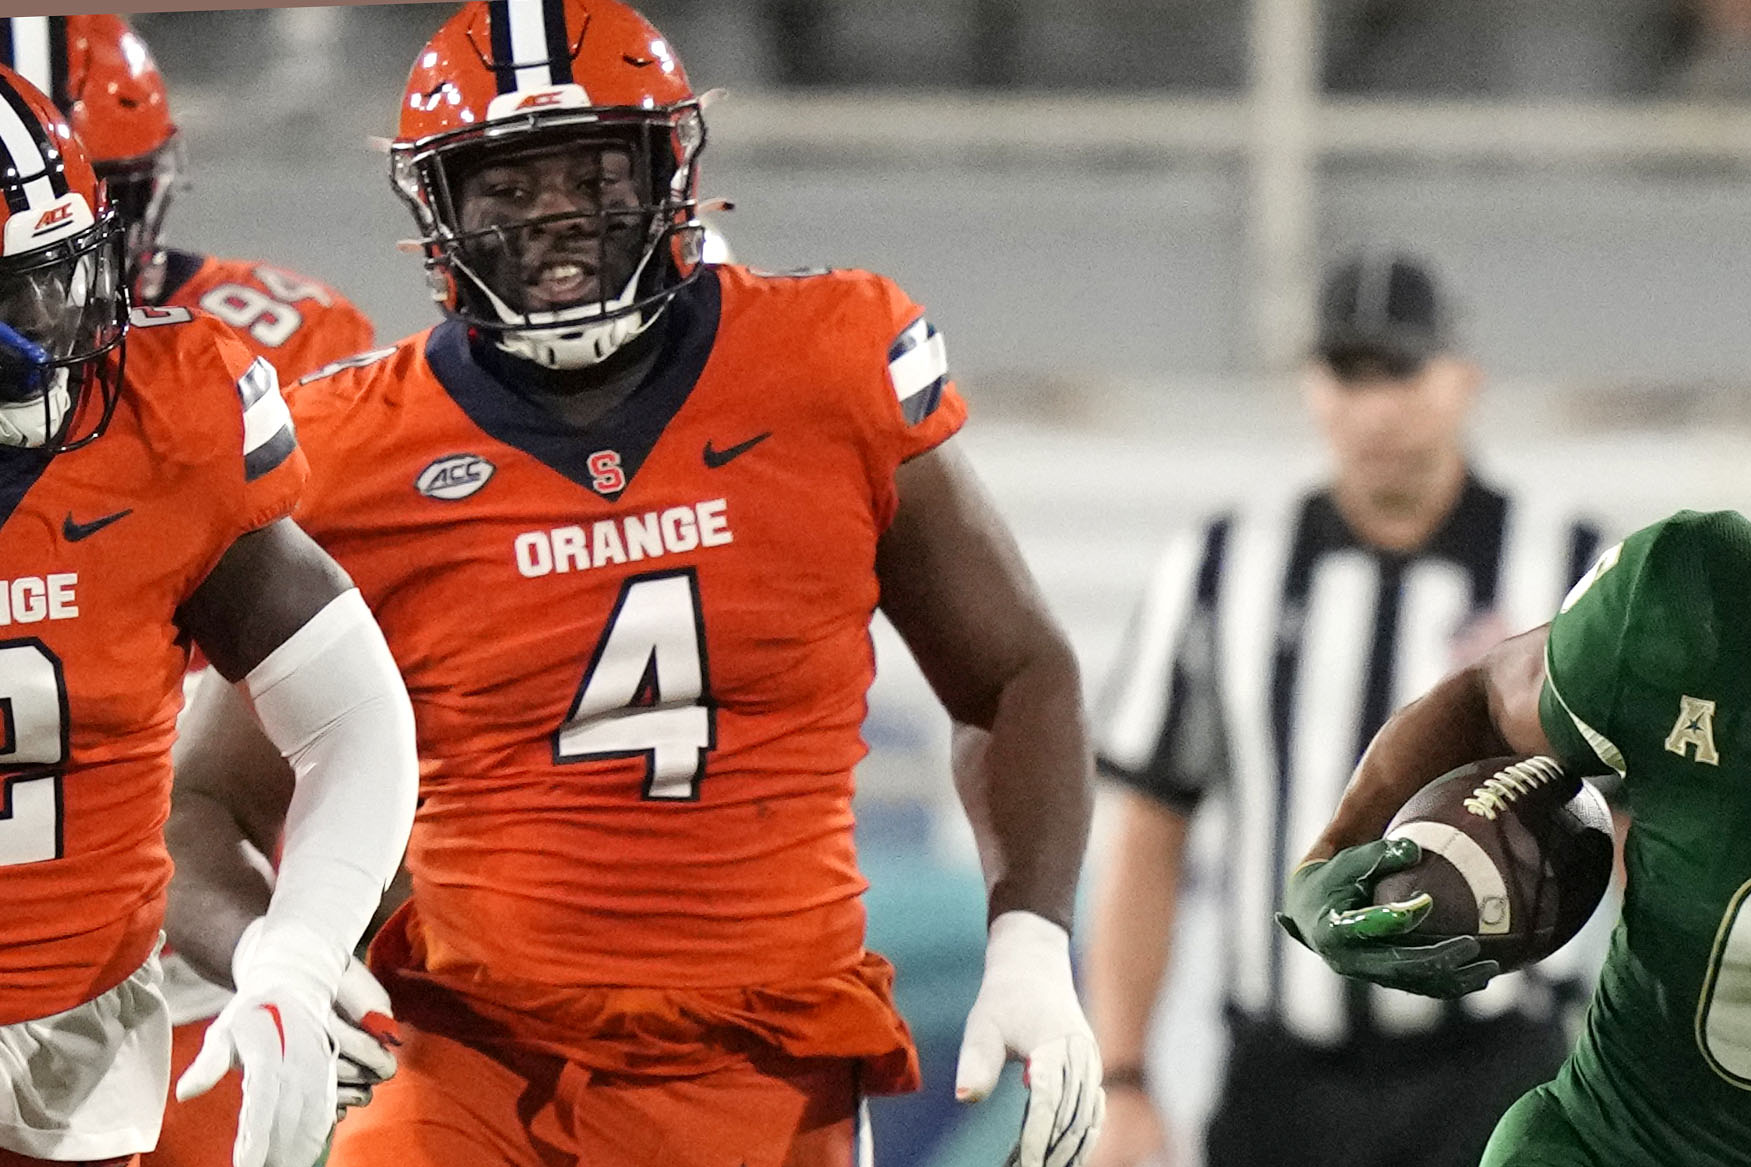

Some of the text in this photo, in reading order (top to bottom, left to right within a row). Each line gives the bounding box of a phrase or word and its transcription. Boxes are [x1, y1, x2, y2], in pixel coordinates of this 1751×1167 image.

[34, 203, 73, 230] ACC
[427, 460, 483, 490] ACC
[587, 450, 626, 494] S
[514, 498, 734, 579] ORANGE
[551, 565, 718, 802] 4
[1664, 694, 1720, 767] A
